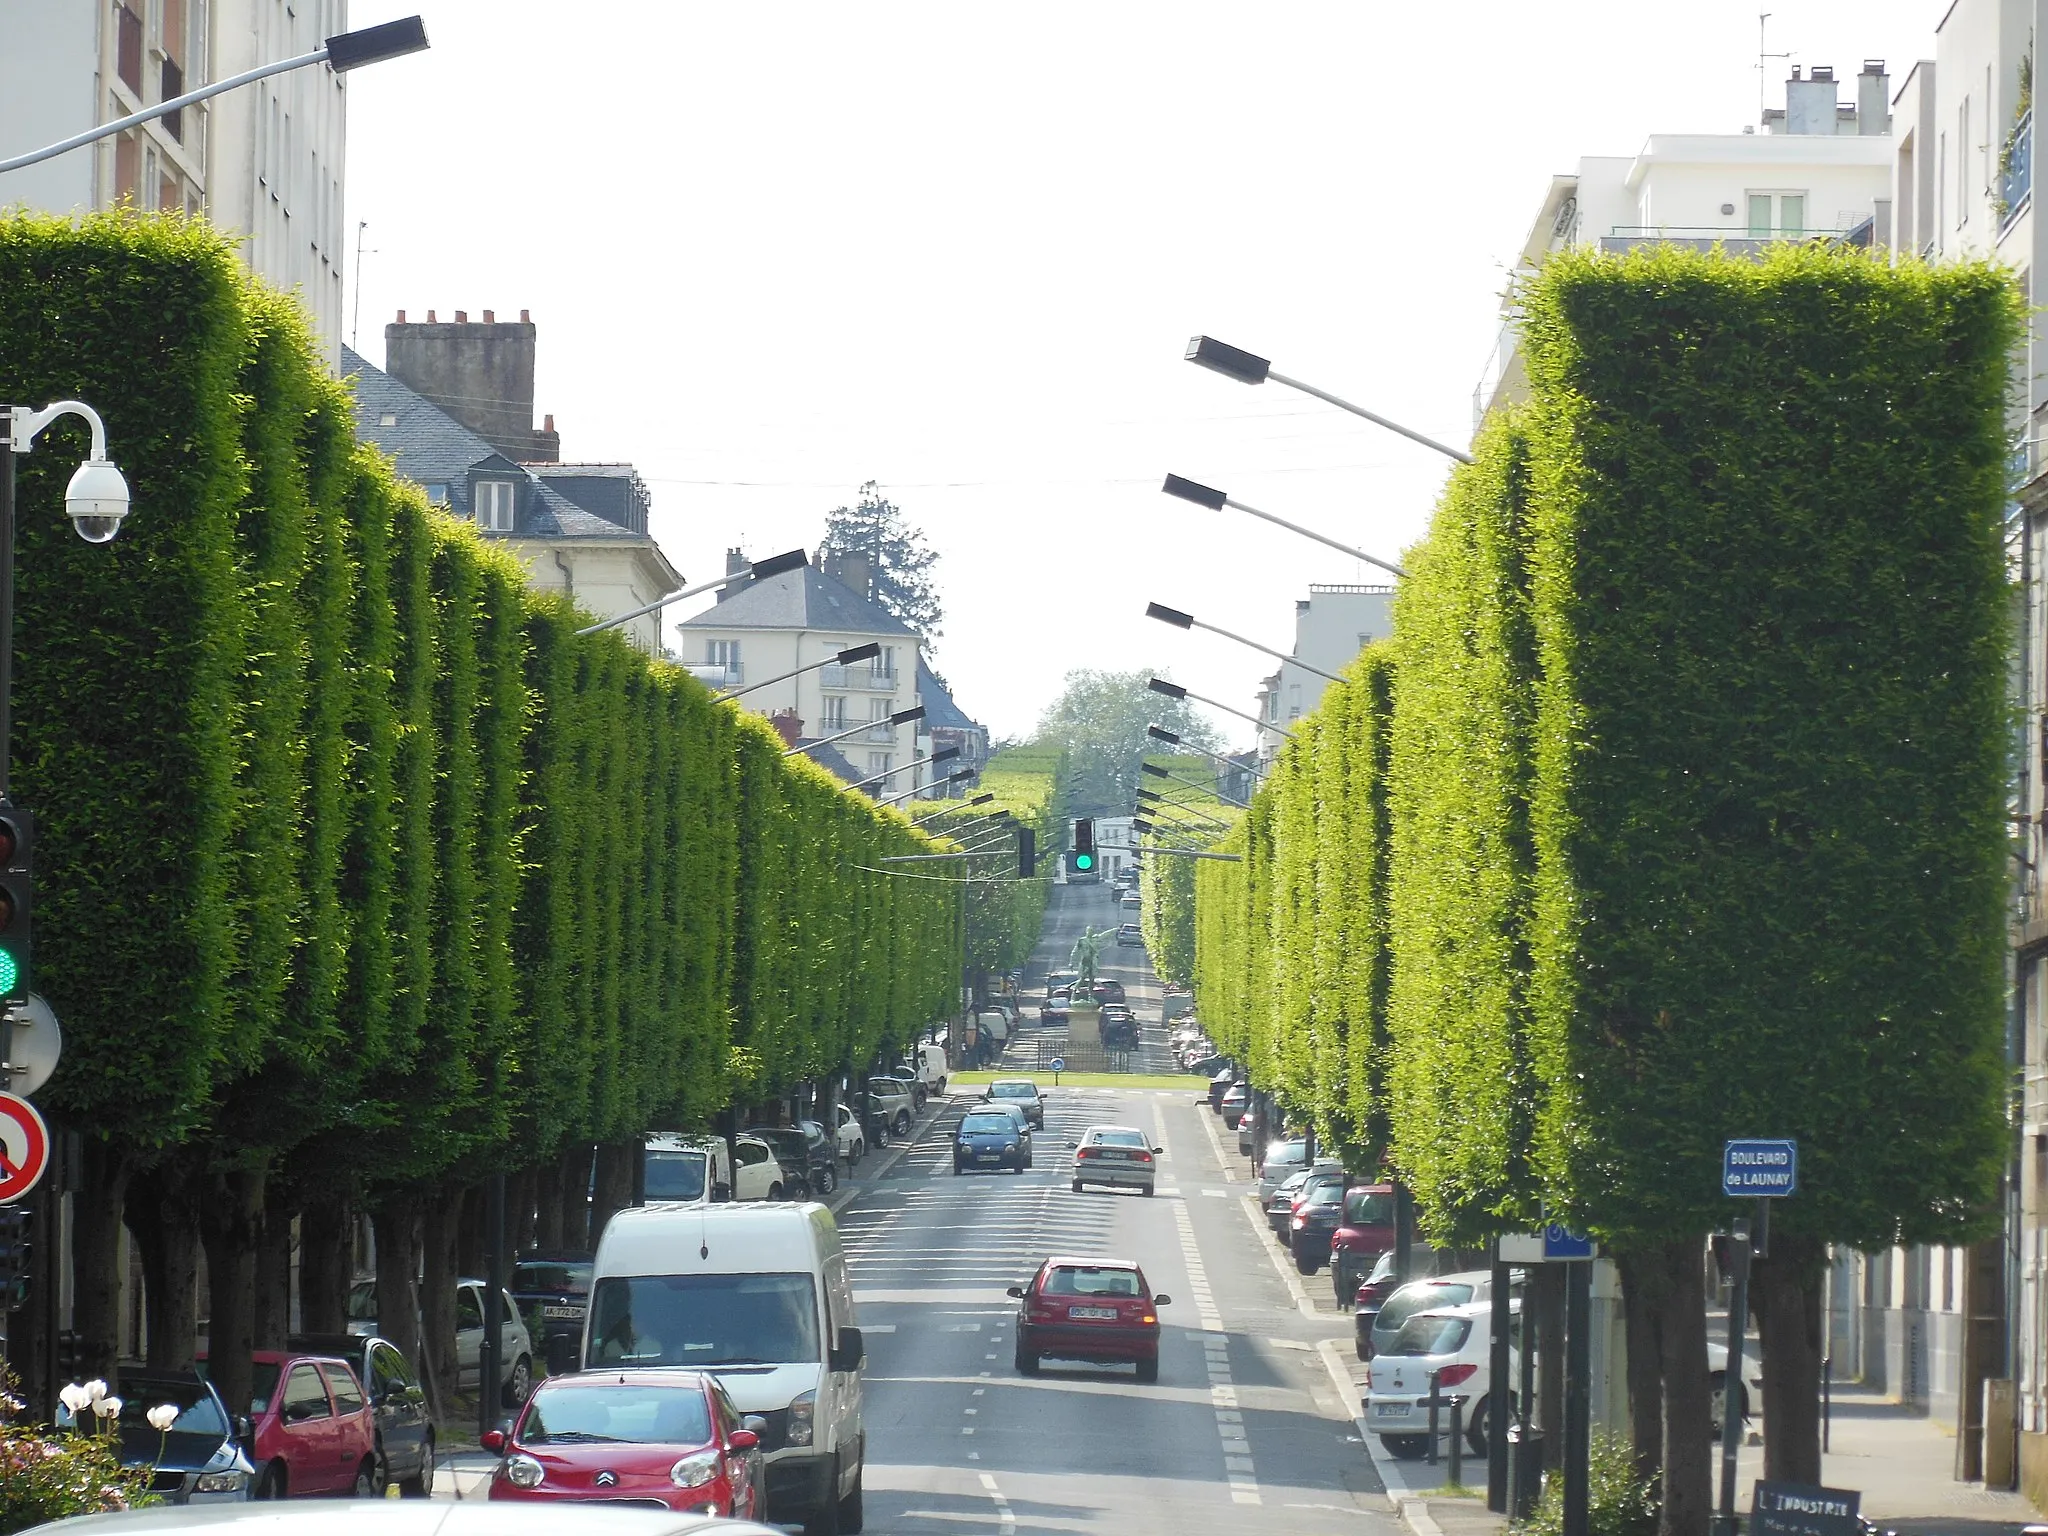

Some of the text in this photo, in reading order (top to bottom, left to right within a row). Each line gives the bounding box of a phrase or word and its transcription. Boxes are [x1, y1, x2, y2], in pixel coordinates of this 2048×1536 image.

[1731, 1152, 1788, 1165] BOULEVARD
[1727, 1173, 1790, 1185] de LAUNAY
[1759, 1490, 1848, 1516] L'INDUSTRIE
